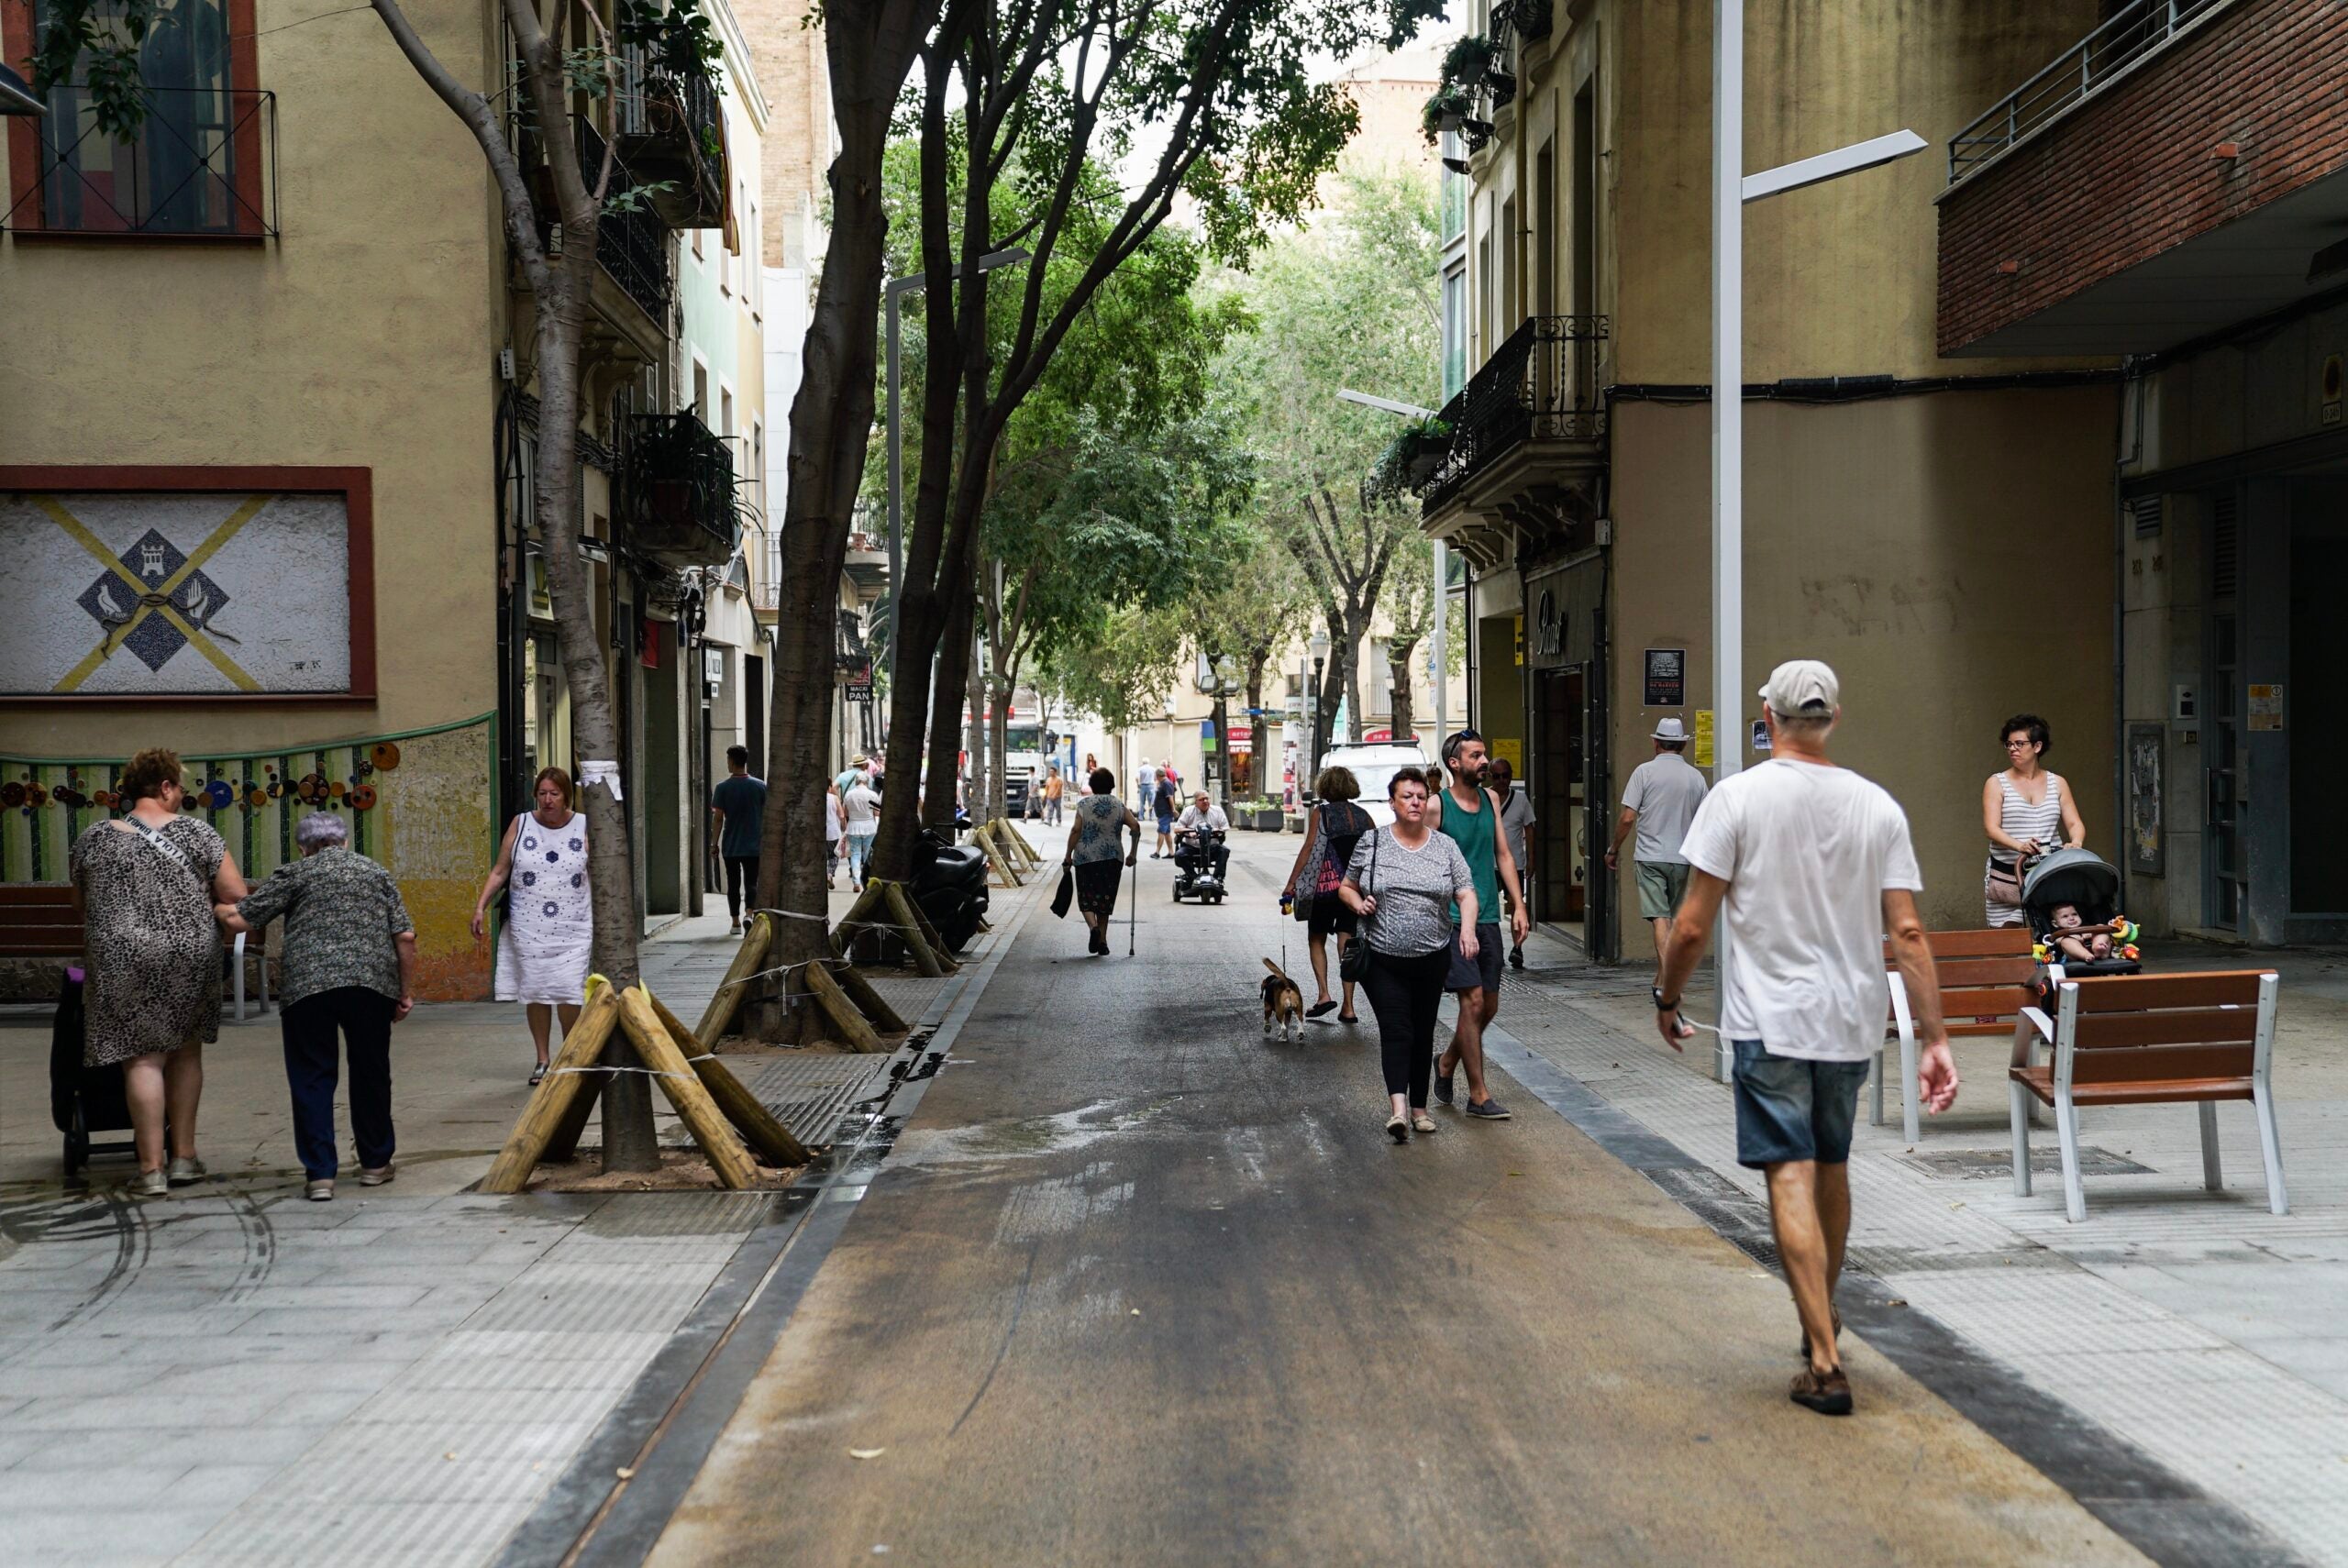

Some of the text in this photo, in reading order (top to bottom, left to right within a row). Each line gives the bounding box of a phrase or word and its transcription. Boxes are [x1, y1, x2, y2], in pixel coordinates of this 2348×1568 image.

[848, 692, 869, 701] PAN
[127, 816, 152, 835] BIMBA
[155, 835, 178, 856] LOLA
